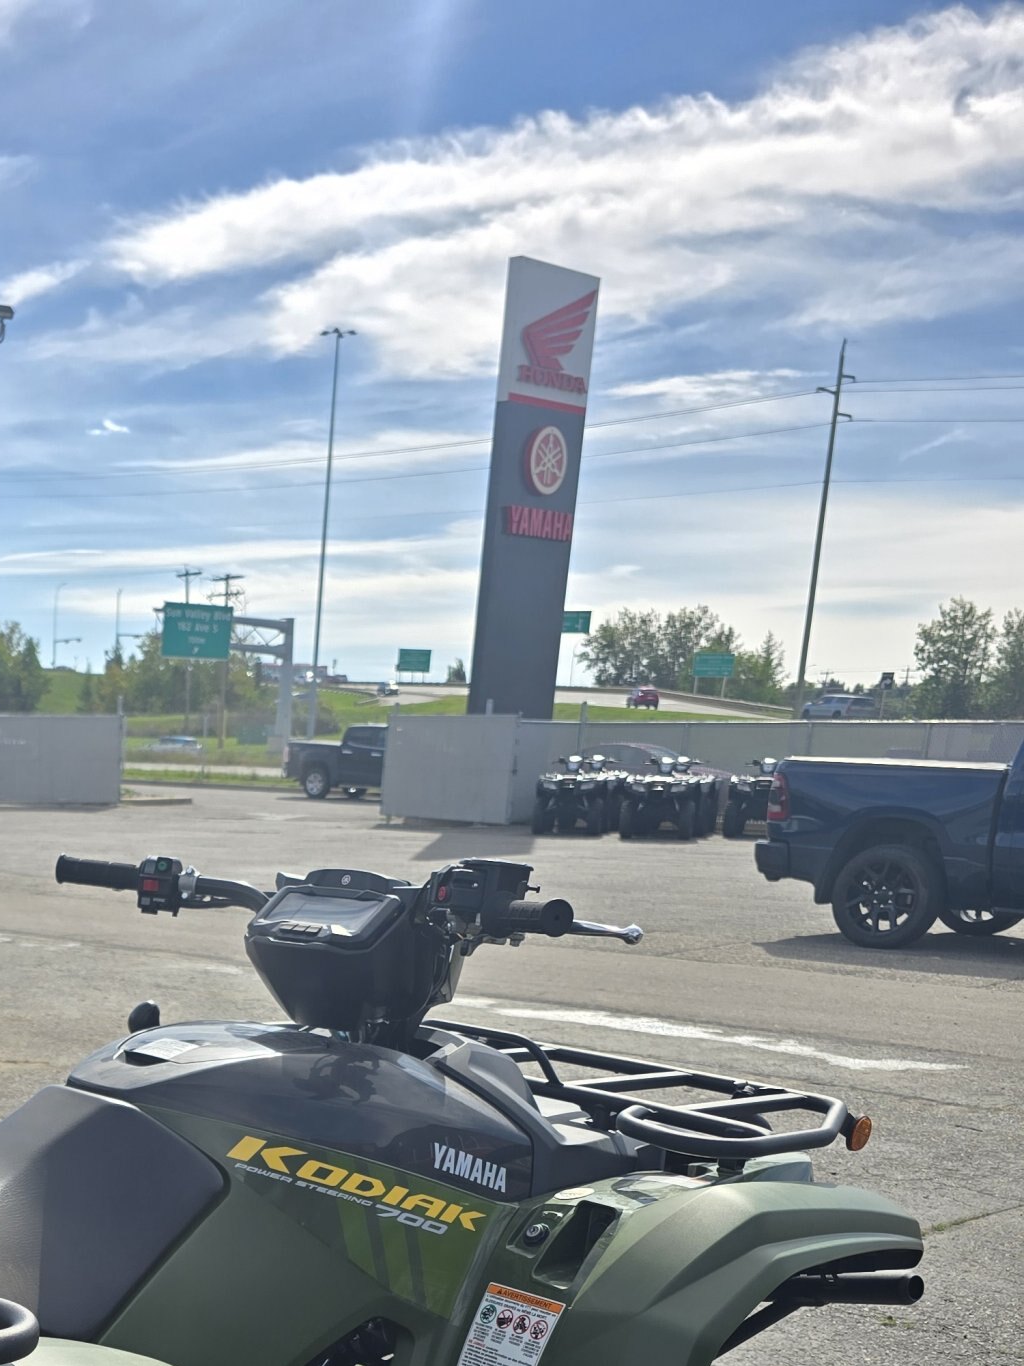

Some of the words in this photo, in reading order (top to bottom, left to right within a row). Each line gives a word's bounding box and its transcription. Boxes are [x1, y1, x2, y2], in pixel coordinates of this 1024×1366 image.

[518, 365, 587, 394] HONDA
[510, 504, 572, 541] YAMAHA
[226, 1135, 487, 1231] KODIAK
[434, 1142, 507, 1193] YAMAHA
[234, 1162, 292, 1183] POWER
[295, 1180, 372, 1207] STEERING
[375, 1204, 448, 1235] 700
[503, 1289, 552, 1309] AVERTISSEMENT
